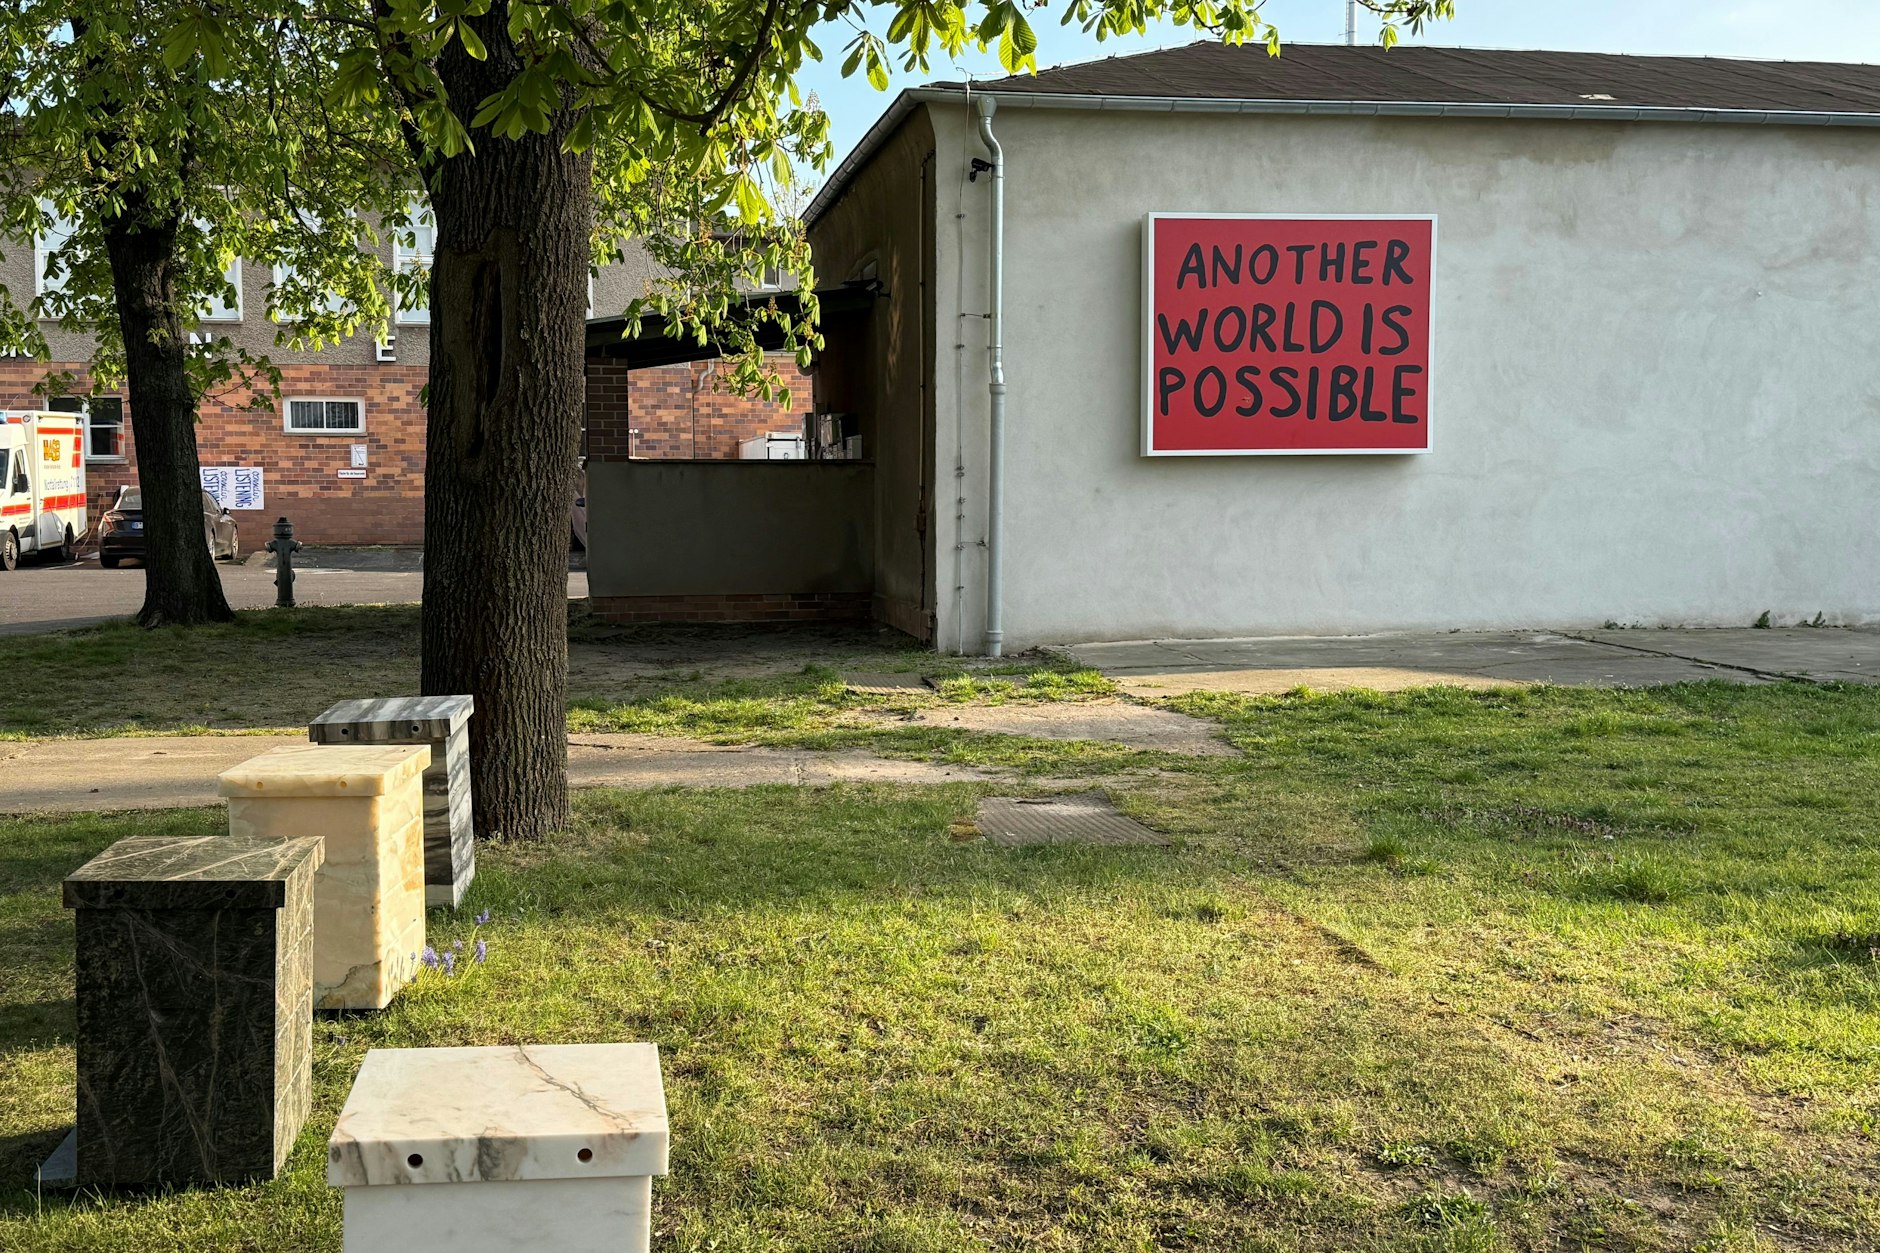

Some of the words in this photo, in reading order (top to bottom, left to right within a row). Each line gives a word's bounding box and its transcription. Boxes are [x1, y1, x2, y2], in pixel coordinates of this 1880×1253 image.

[1177, 239, 1414, 290] ANOTHER
[1157, 299, 1344, 356] WORLD
[1360, 302, 1413, 356] IS
[1159, 364, 1423, 424] POSSIBLE
[202, 468, 220, 504] LISTEN
[235, 468, 252, 508] LISTENING
